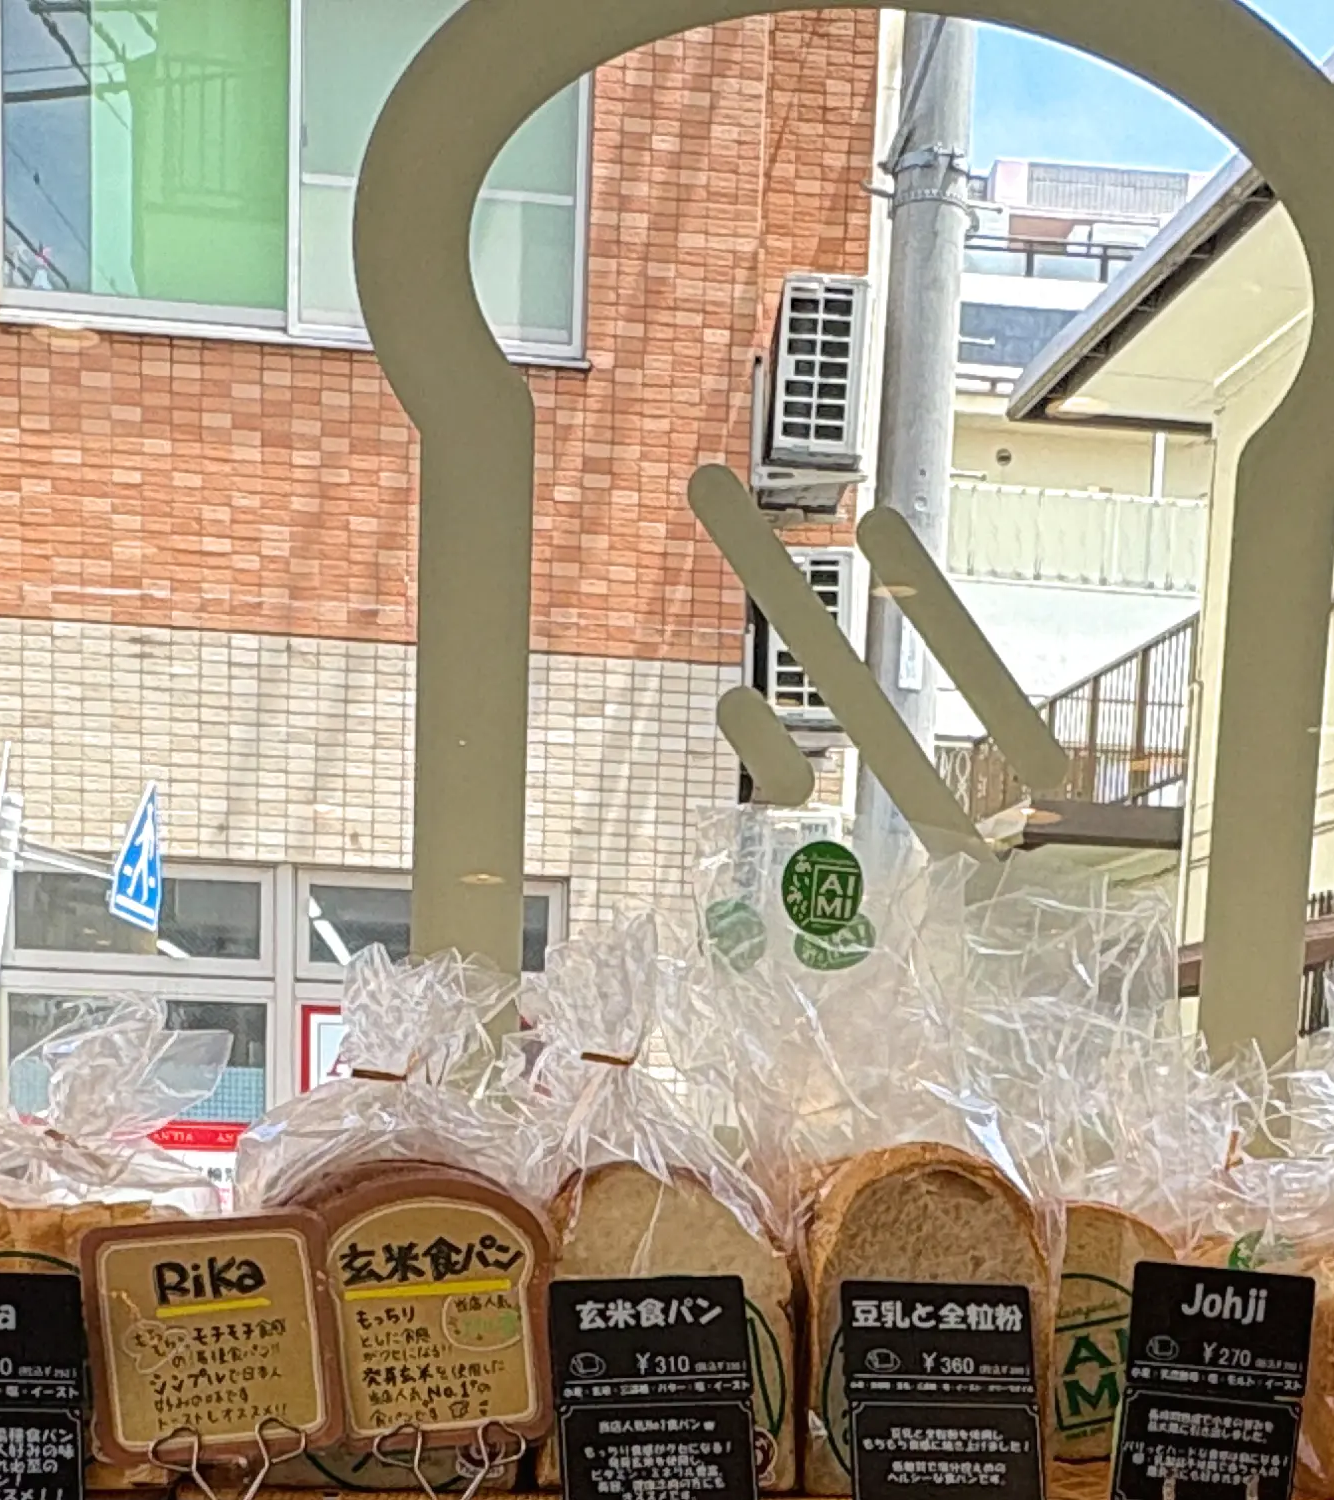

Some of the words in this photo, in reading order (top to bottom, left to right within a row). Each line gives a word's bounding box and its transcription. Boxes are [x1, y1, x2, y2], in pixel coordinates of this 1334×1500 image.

[819, 873, 855, 895] AI
[817, 897, 851, 919] MI
[339, 1234, 525, 1287] 玄米食パン
[153, 1256, 266, 1305] Rika
[575, 1297, 723, 1330] 玄米食パン
[852, 1299, 1024, 1332] 豆乳と全粒粉
[1181, 1283, 1269, 1325] Johji
[356, 1306, 416, 1330] もっちり
[635, 1352, 690, 1375] ¥310
[922, 1351, 975, 1375] ¥360
[1203, 1341, 1253, 1368] ¥270
